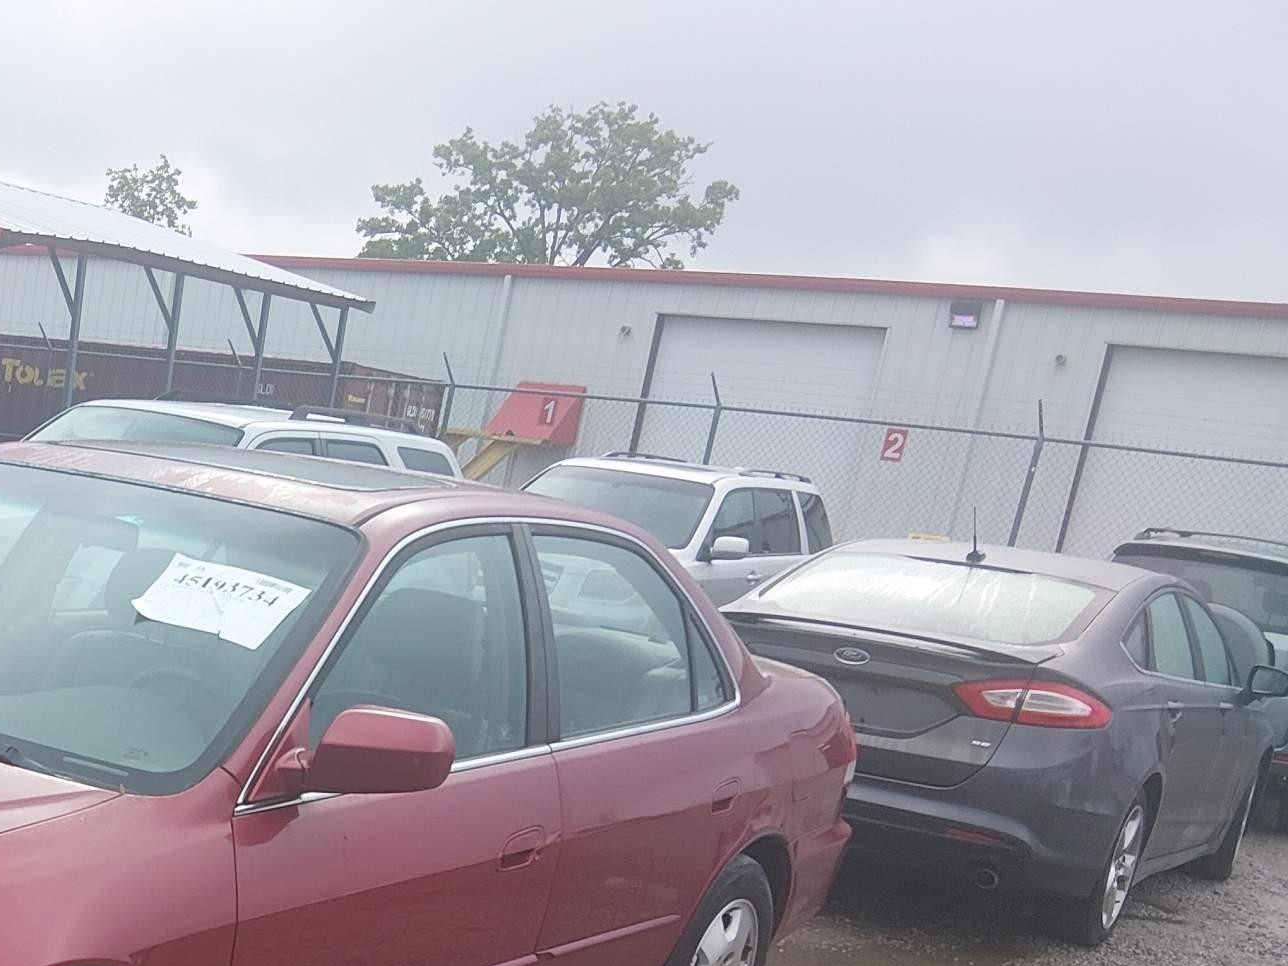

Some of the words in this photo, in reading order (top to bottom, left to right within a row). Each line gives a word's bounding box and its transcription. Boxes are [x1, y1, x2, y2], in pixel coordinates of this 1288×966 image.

[543, 399, 557, 424] 1
[883, 432, 905, 459] 2
[173, 573, 280, 607] 45193734
